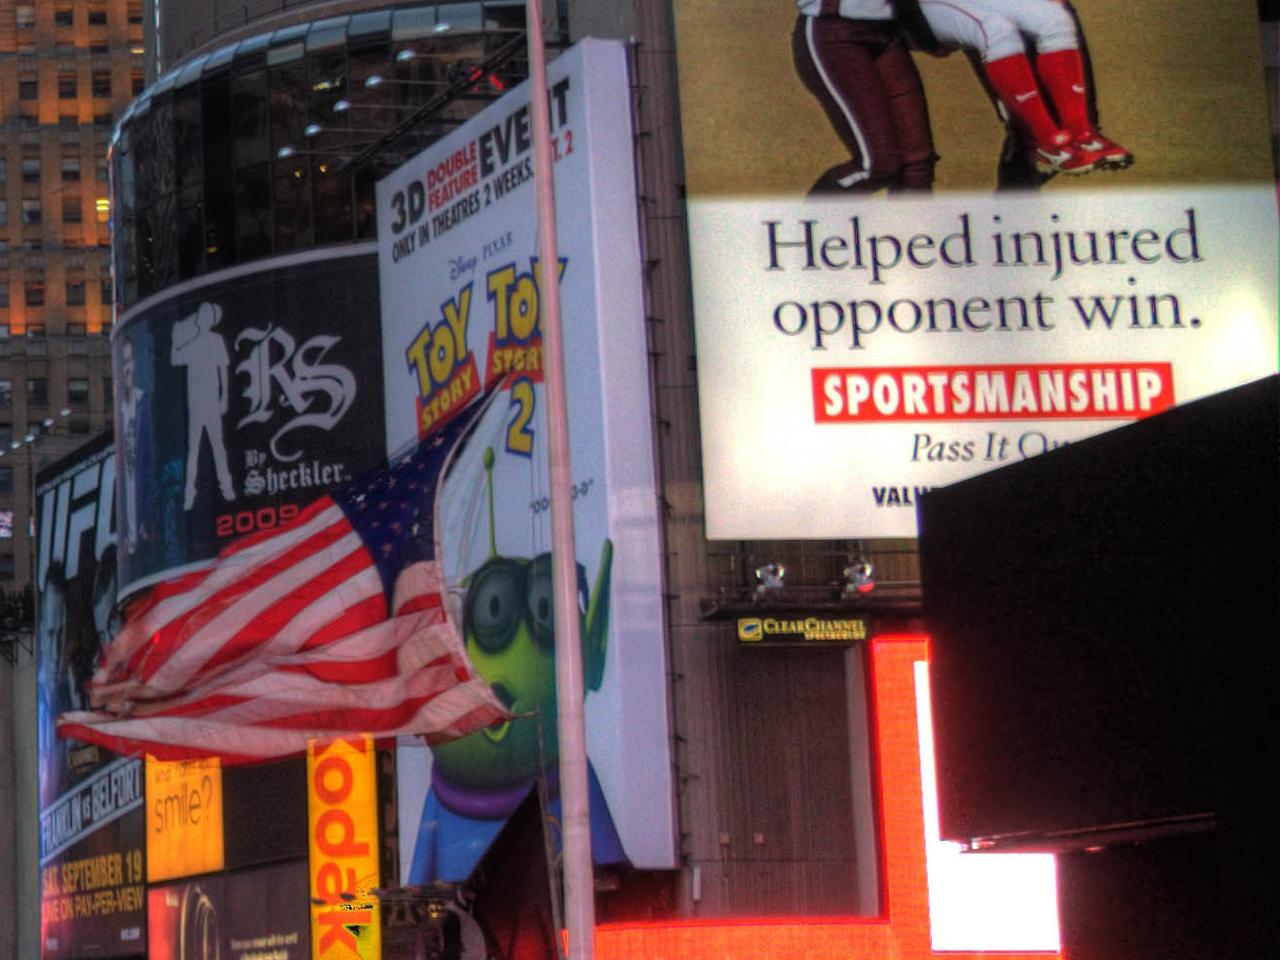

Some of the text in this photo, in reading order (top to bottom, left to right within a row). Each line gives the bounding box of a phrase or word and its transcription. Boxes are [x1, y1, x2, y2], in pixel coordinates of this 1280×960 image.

[391, 77, 569, 235] 3D DOUBLE EVET
[393, 231, 416, 263] ONLY
[420, 223, 430, 248] IN
[432, 190, 480, 239] THEATRES
[483, 184, 492, 205] 2
[565, 129, 573, 155] 2
[428, 165, 478, 214] FEATURE
[482, 231, 513, 260] PIXAR
[761, 207, 1204, 285] Helped injured
[405, 280, 474, 405] TOY
[773, 276, 1203, 350] opponent win.
[235, 323, 356, 462] RS
[422, 362, 473, 432] STORY
[505, 375, 536, 459] 2
[823, 369, 1163, 417] SPORTSMANSHIP
[244, 449, 266, 467] By
[244, 460, 344, 496] Sheckler
[911, 433, 975, 463] Pass
[984, 433, 1010, 463] It
[215, 503, 299, 537] 2009
[92, 760, 142, 823] BELFORT
[155, 775, 211, 833] smile?
[62, 852, 121, 893] SEPTEMBER
[126, 848, 142, 883] 19
